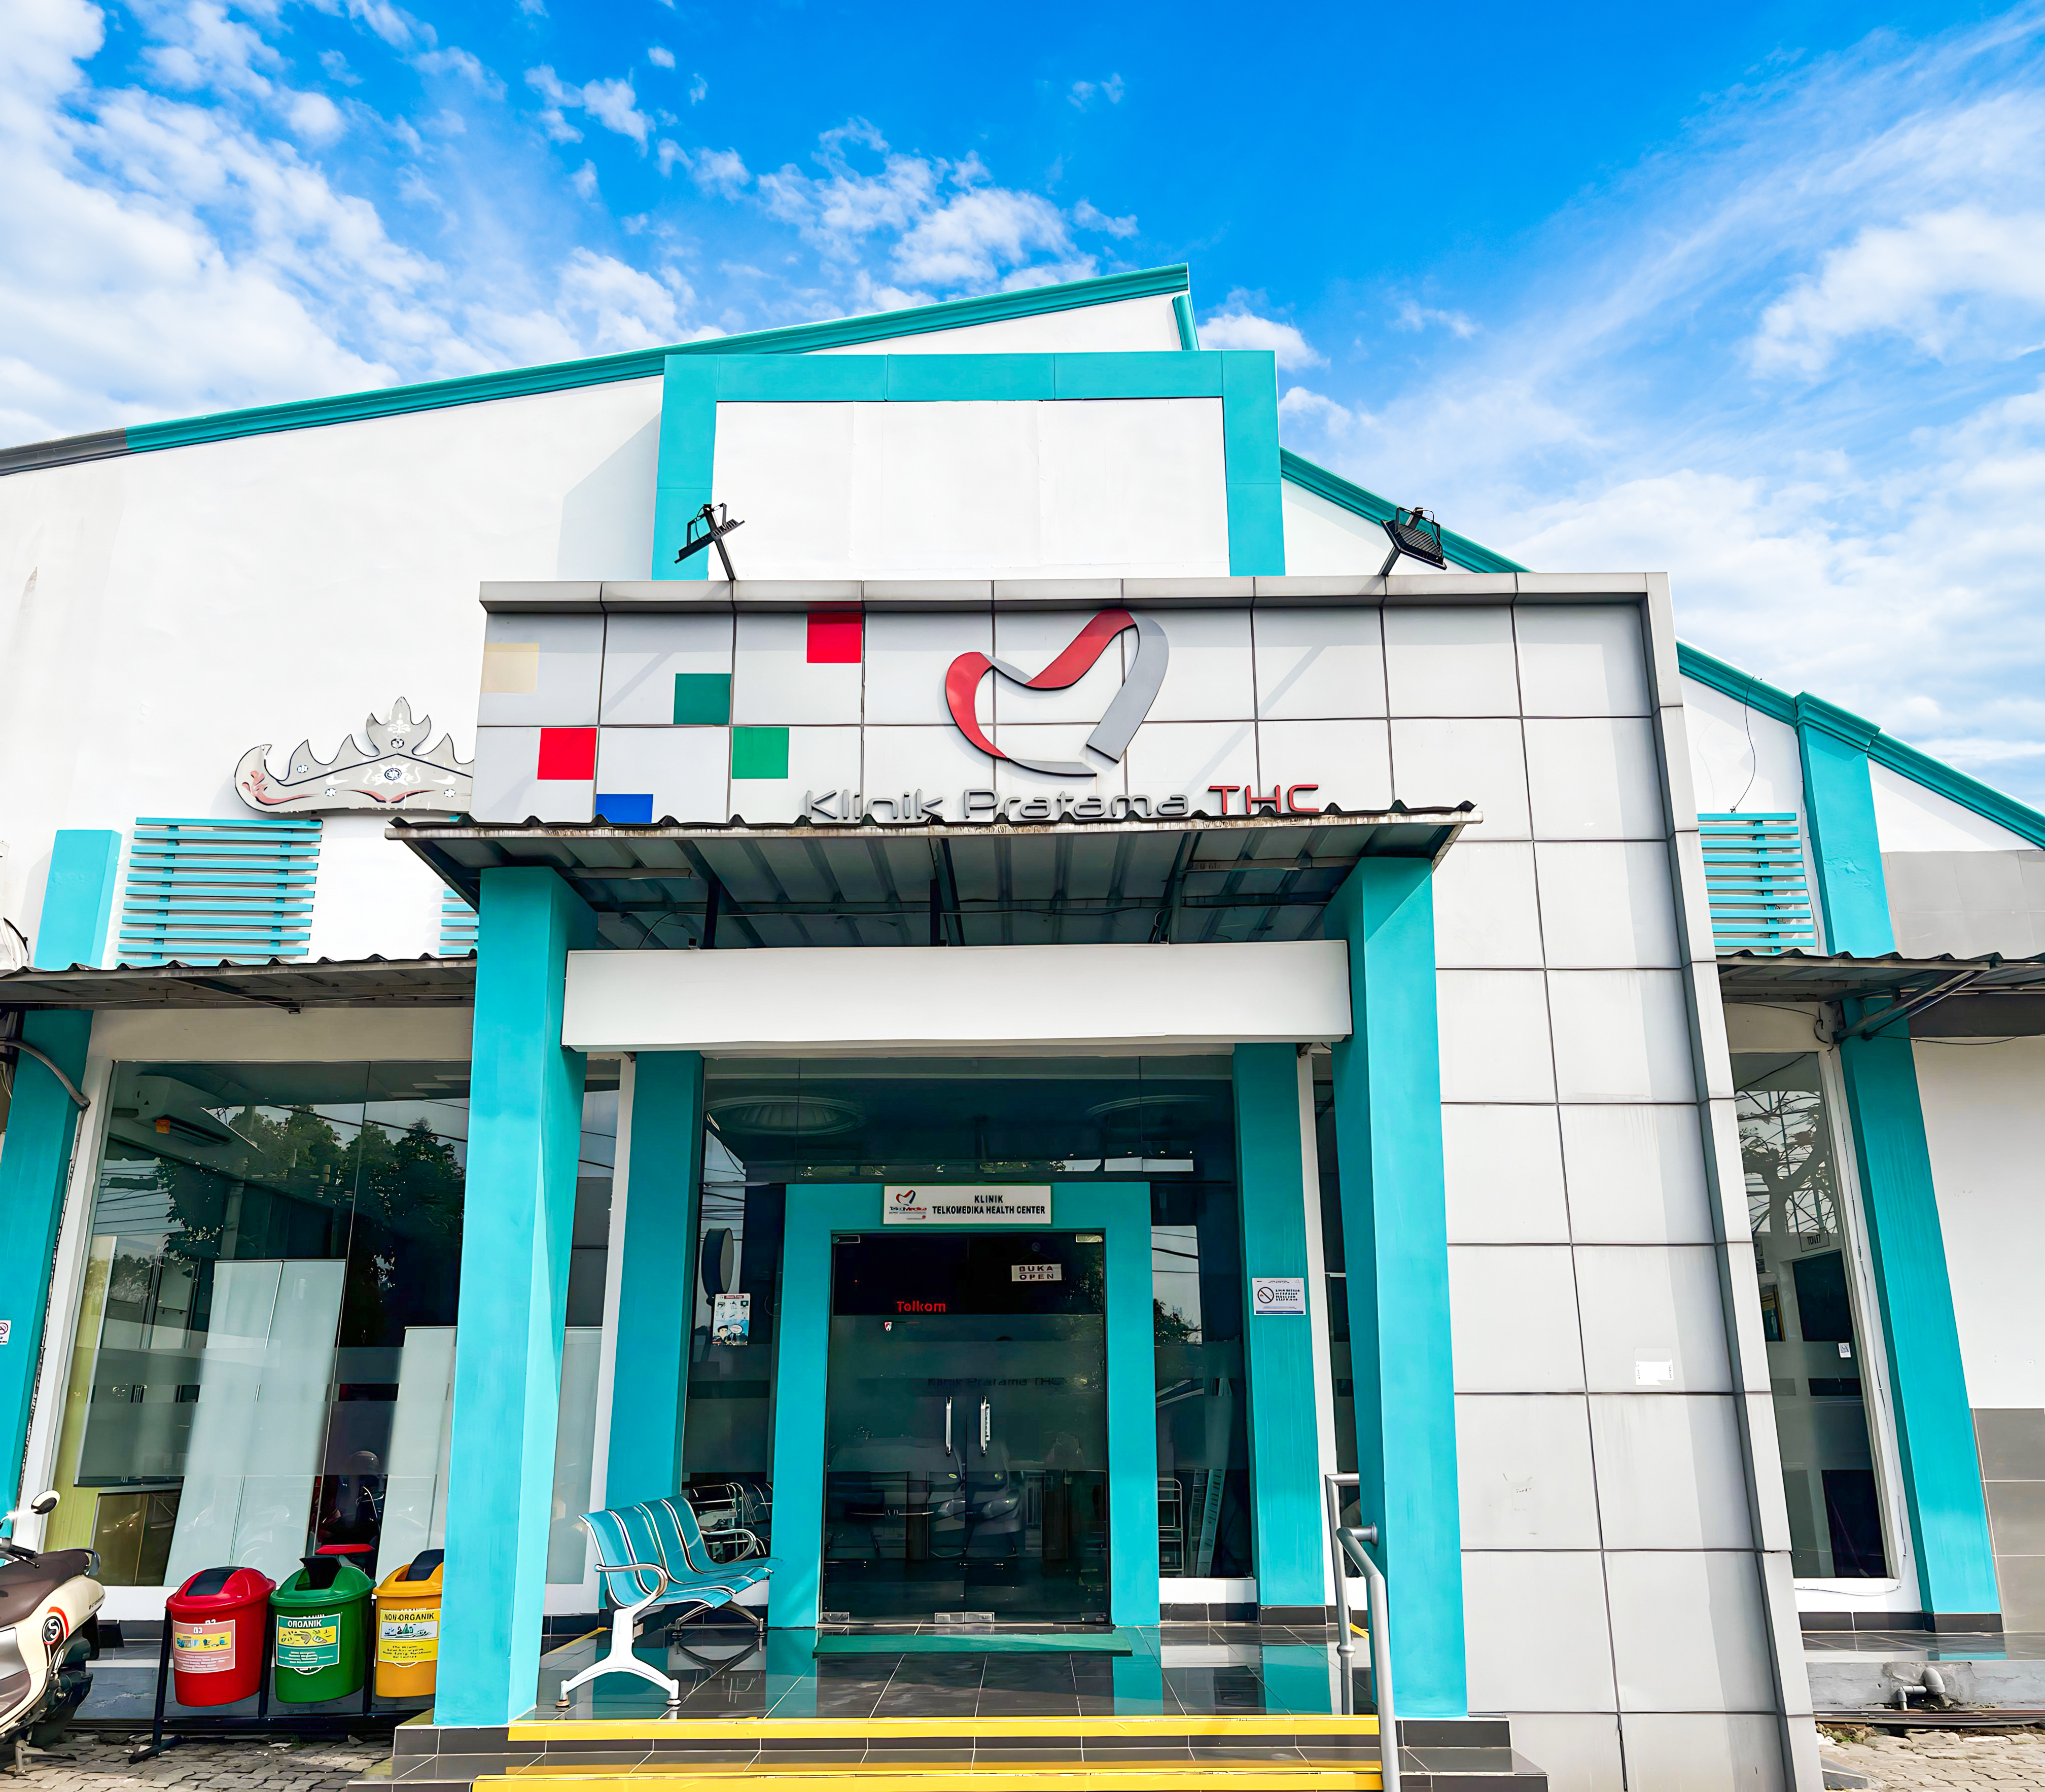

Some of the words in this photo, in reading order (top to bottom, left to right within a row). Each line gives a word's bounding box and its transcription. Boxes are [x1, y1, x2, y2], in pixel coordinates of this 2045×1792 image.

[805, 788, 943, 820] Klinik
[964, 789, 1189, 819] Pratama
[1208, 784, 1320, 815] THC
[974, 1195, 1003, 1203] KLINIK
[932, 1206, 984, 1214] TELKOMEDIKA
[986, 1206, 1014, 1214] HEALTH
[1017, 1206, 1045, 1214] CENTER
